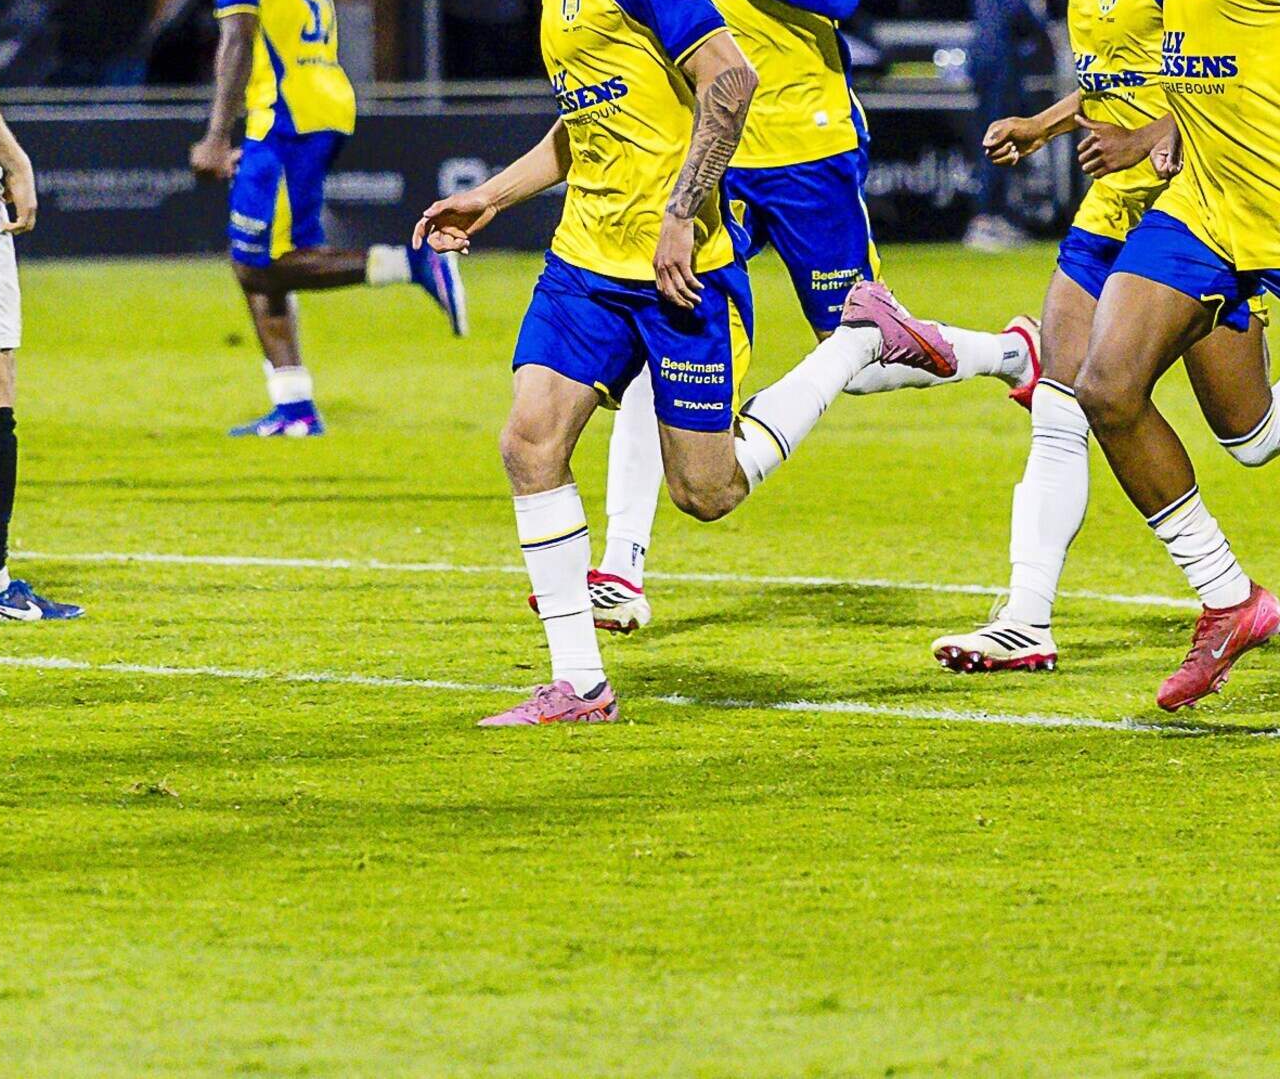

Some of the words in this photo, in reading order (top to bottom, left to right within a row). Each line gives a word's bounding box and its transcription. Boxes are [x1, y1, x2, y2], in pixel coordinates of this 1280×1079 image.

[660, 356, 726, 374] Beekmans
[660, 369, 726, 384] Heftrucks
[673, 399, 724, 411] STANNO
